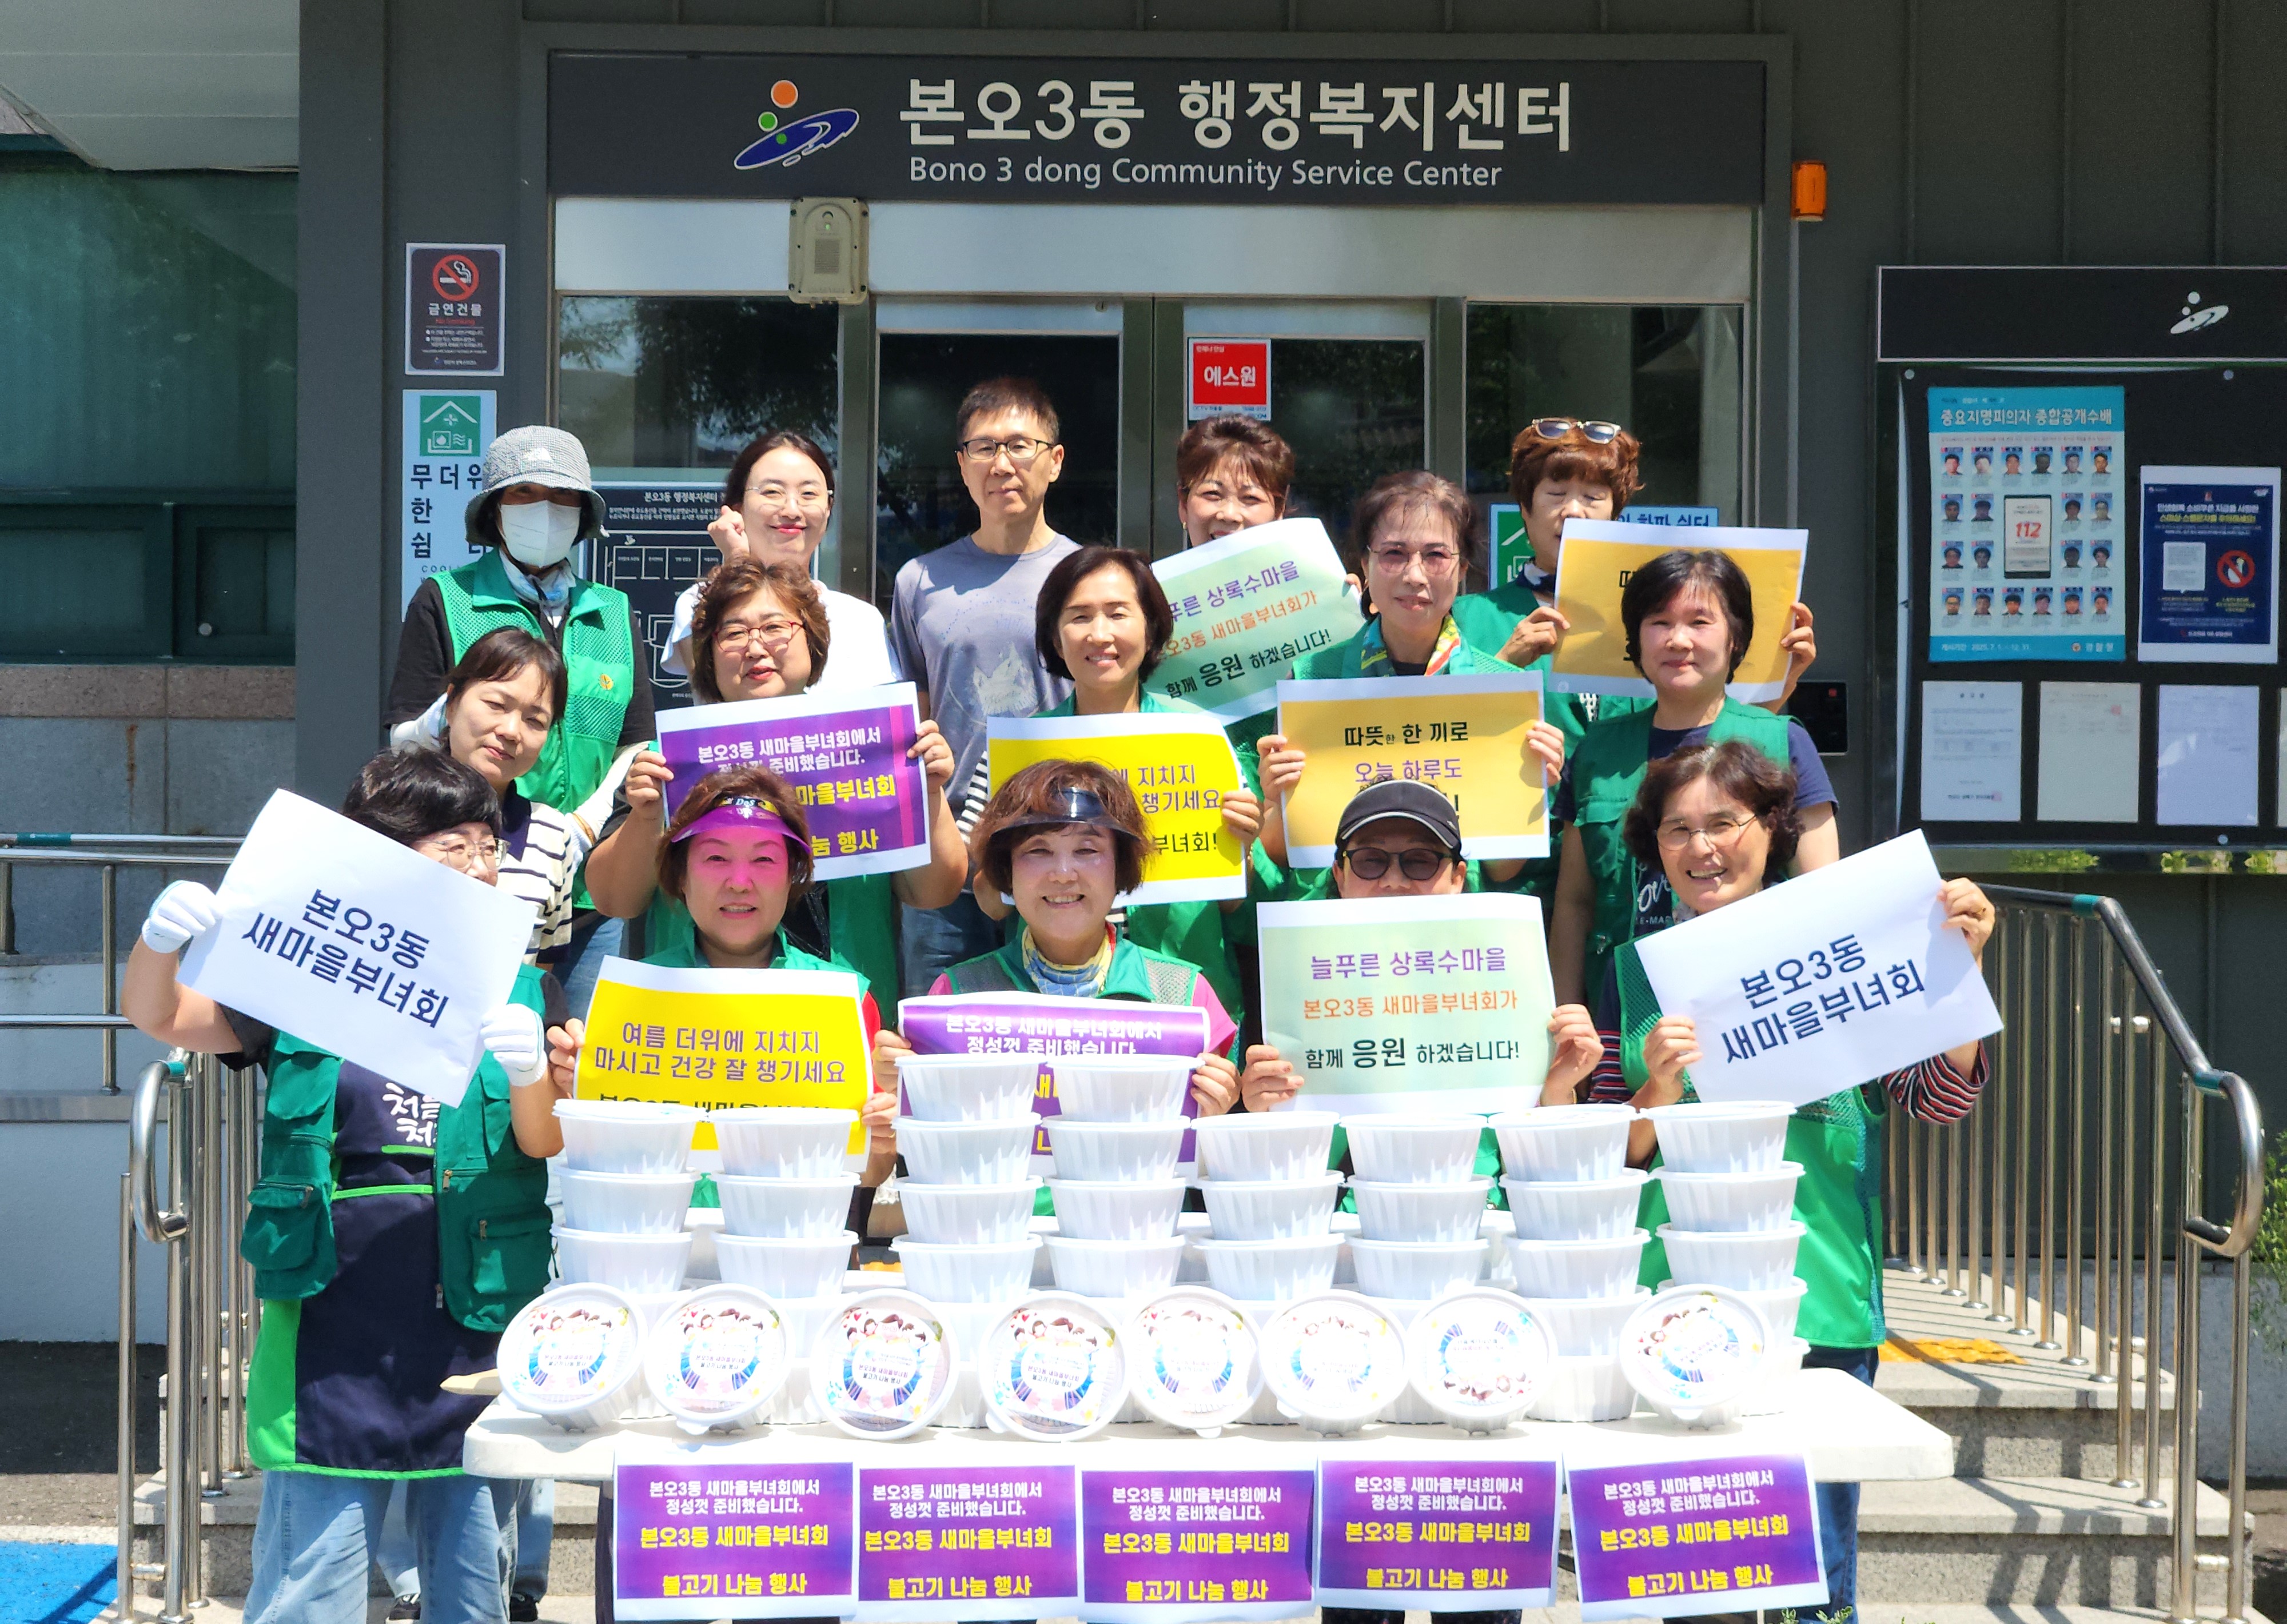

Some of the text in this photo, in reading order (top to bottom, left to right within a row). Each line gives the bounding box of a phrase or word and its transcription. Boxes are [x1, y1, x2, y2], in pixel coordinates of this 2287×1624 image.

[900, 78, 1569, 152] 본오3동 행정복지센터
[910, 155, 1502, 190] Bono 3 dong Community Service Center
[429, 302, 482, 317] 금연건물
[1204, 365, 1256, 388] 에스원
[411, 497, 433, 524] 한
[2016, 521, 2042, 538] 112
[1168, 560, 1301, 622] 푸른 상록수마을
[1163, 589, 1318, 659] 오3동 새마을부녀회가
[1165, 628, 1332, 699] 함께 응원 하겠습니다!
[698, 726, 881, 765] 본오3동 새마을부녀회에서
[1344, 721, 1469, 747] 따뜻한 한 끼로
[769, 749, 866, 775] 준비했습니다.
[1354, 758, 1463, 783] 오늘 하루도
[1138, 764, 1196, 787] 지치지
[796, 773, 897, 806] 마을부녀회
[1142, 789, 1221, 814] 챙기세요
[811, 828, 879, 857] 눔 행사
[1154, 832, 1218, 854] 부녀회!
[302, 889, 431, 971] 본오3동
[241, 911, 449, 1028] 새마을부녀회
[1310, 947, 1507, 980] 늘푸른 상록수마을
[1740, 932, 1867, 1009] 본오3동
[1303, 989, 1519, 1020] 본오3동 새마을부녀회가
[1720, 959, 1925, 1064] 새마을부녀회
[622, 1022, 819, 1054] 여름 더위에 지치지
[946, 1013, 1162, 1040] 본오3동 새마을부녀회에서
[967, 1036, 1021, 1054] 정성껏
[1305, 1037, 1520, 1070] 함께 응원 하겠습니다!
[595, 1046, 846, 1083] 마시고 건강 잘 챙기세요
[396, 1118, 437, 1147] 처
[650, 1479, 820, 1498] 본오3동 새마을부녀회에서
[873, 1482, 1042, 1501] 본오3동 새마을부녀회에서
[1113, 1486, 1281, 1504] 본오3동 새마을부녀회에서
[1355, 1476, 1524, 1494] 본오3동 새마을부녀회에서
[1604, 1469, 1774, 1501] 본오3동 새마을부녀회에서
[666, 1497, 803, 1515] 정성껏 준비했습니다.
[889, 1501, 1026, 1519] 정성껏 준비했습니다.
[1129, 1505, 1265, 1522] 정성껏 준비했습니다.
[1371, 1495, 1507, 1512] 정성껏 준비했습니다.
[1622, 1489, 1760, 1517] 정성껏 준비했습니다.
[641, 1524, 829, 1549] 본오3동 새마을부녀회
[864, 1526, 1052, 1552] 본오3동 새마을부녀회
[1103, 1531, 1290, 1554] 본오3동 새마을부녀회
[1345, 1521, 1531, 1543] 본오3동 새마을부녀회
[1600, 1514, 1790, 1552] 본오3동 새마을부녀회
[663, 1573, 807, 1597] 불고기 나눔 행사
[888, 1575, 1032, 1599] 불고기 나눔 행사
[1125, 1579, 1269, 1602] 불고기 나눔 행사
[1366, 1568, 1508, 1590] 불고기 나눔 행사
[1627, 1563, 1774, 1598] 불고기 나눔 행사
